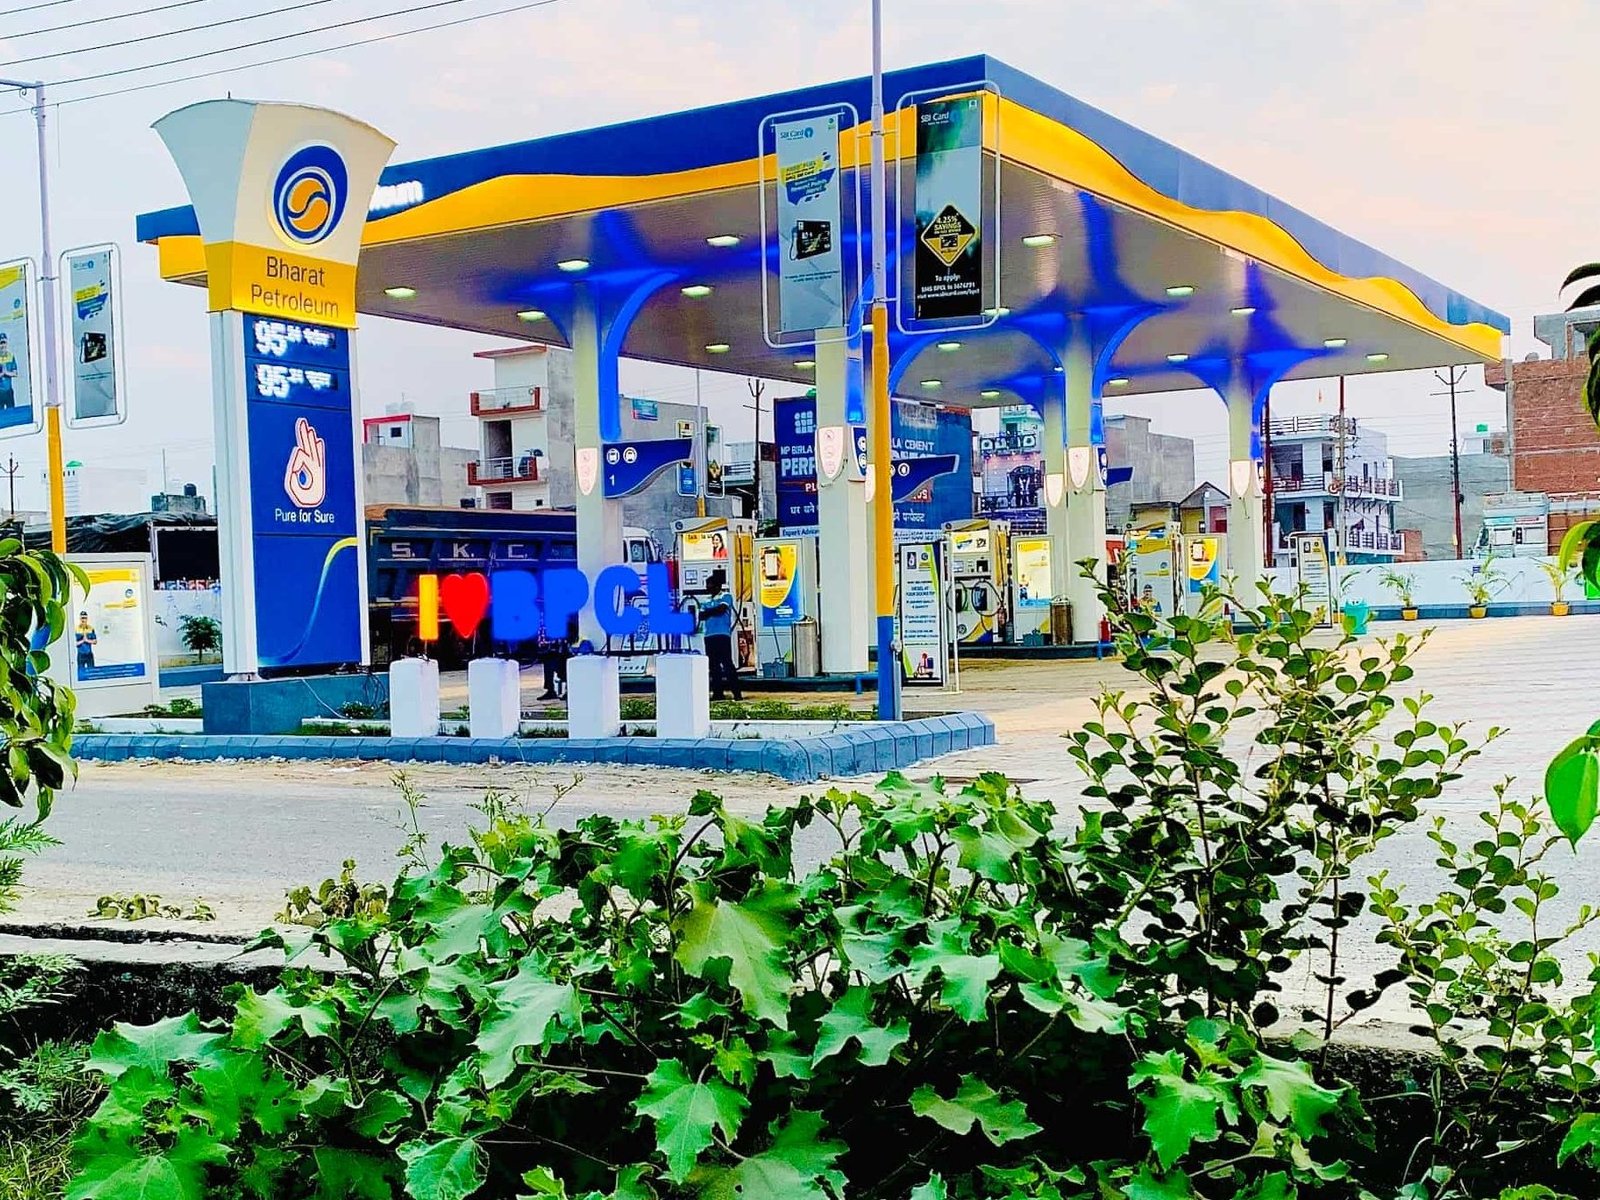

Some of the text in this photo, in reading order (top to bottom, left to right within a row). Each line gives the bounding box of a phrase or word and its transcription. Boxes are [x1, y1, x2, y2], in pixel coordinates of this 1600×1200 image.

[932, 111, 949, 121] Card
[267, 256, 325, 288] Bharat
[251, 284, 339, 318] Petroleum
[791, 444, 813, 455] BIRLA
[892, 437, 935, 452] LA CEMENT
[781, 456, 816, 477] PERF
[609, 474, 615, 486] 1
[804, 482, 817, 492] PL
[275, 508, 335, 524] Pure for Sure
[452, 542, 475, 559] K.
[418, 563, 698, 641] I BPCL
